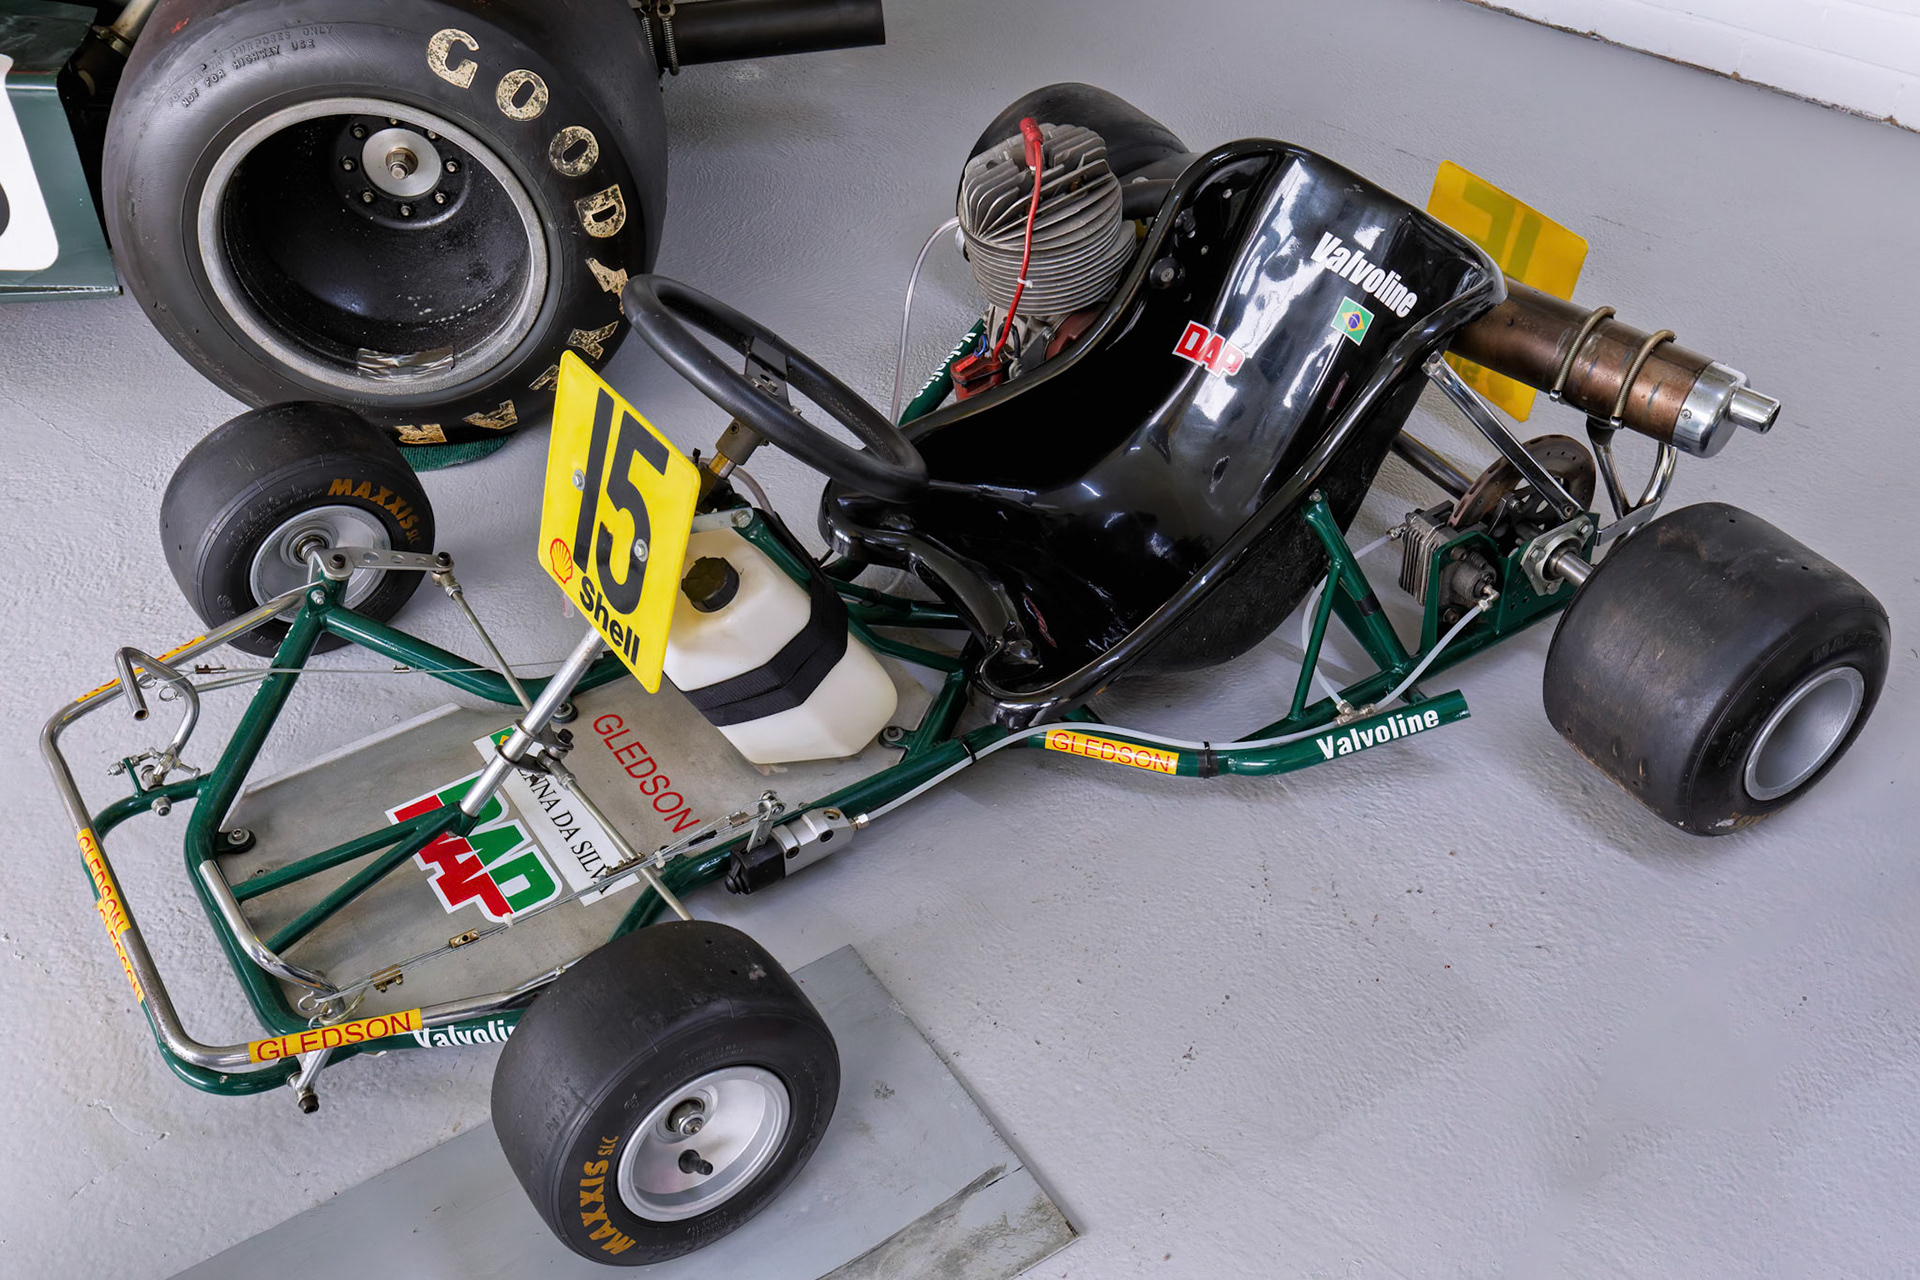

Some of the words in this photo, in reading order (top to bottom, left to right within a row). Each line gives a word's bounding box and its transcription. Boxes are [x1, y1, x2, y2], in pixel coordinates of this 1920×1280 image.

[231, 30, 292, 58] PURPOSES
[302, 25, 333, 37] ONLY
[181, 88, 200, 108] NOT
[204, 68, 226, 88] FOR
[232, 45, 281, 70] HIGHWAY
[291, 39, 316, 51] USE
[1310, 231, 1418, 318] Valvoline
[1173, 321, 1245, 377] DAP
[327, 478, 419, 529] MAXXIS
[573, 387, 670, 615] 15
[580, 576, 640, 667] Shell
[1052, 732, 1171, 772] GLEDSON
[1315, 709, 1440, 760] Valvoline
[593, 713, 701, 834] GLEDSON
[550, 810, 581, 842] DA
[257, 1012, 412, 1061] GLEDSON
[597, 1135, 619, 1156] SLC
[579, 1159, 636, 1255] MAXXIS
